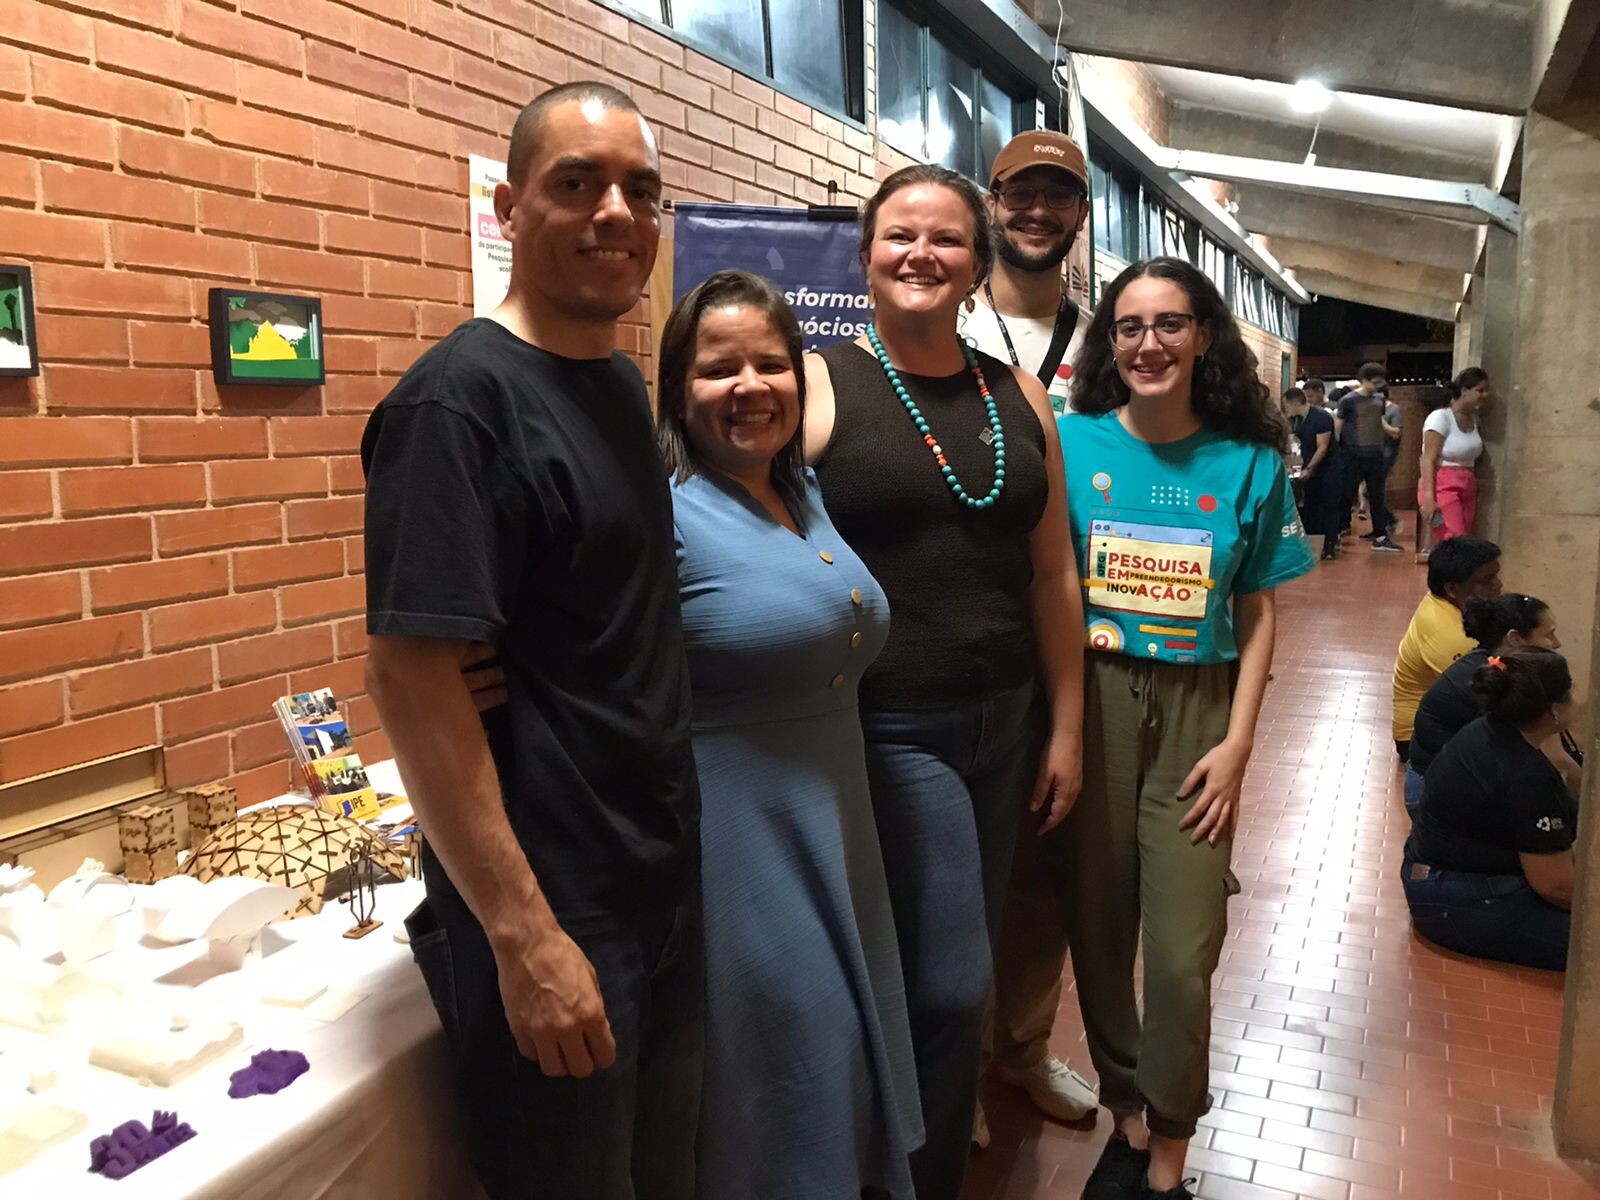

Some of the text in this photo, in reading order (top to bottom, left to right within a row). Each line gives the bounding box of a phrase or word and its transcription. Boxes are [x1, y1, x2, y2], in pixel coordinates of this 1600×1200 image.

[784, 287, 875, 309] sforma
[1108, 552, 1202, 576] PESQUISA
[1106, 582, 1191, 602] INOVAÇÃO
[350, 795, 366, 810] IPE
